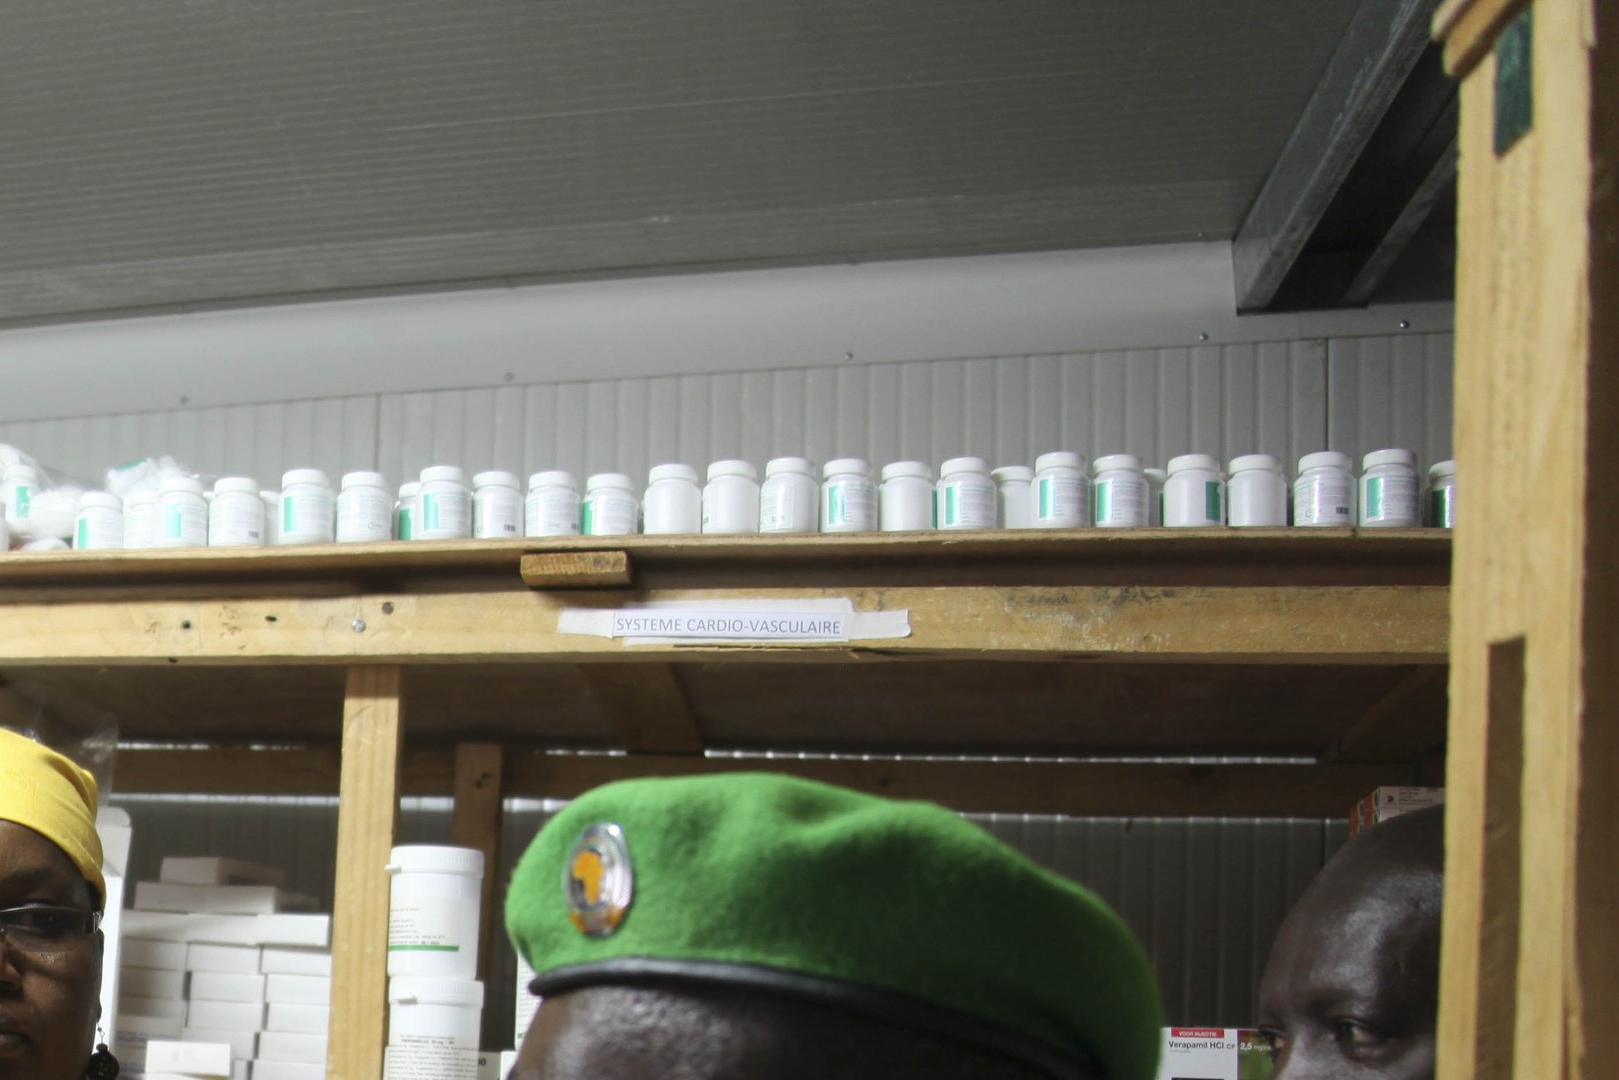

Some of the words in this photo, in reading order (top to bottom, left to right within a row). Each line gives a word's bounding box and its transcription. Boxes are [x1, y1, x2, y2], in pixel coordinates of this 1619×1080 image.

[615, 617, 682, 633] SYSTEME
[686, 618, 842, 635] CARDIO-VASCULAIRE
[1168, 1041, 1208, 1050] Verapamil
